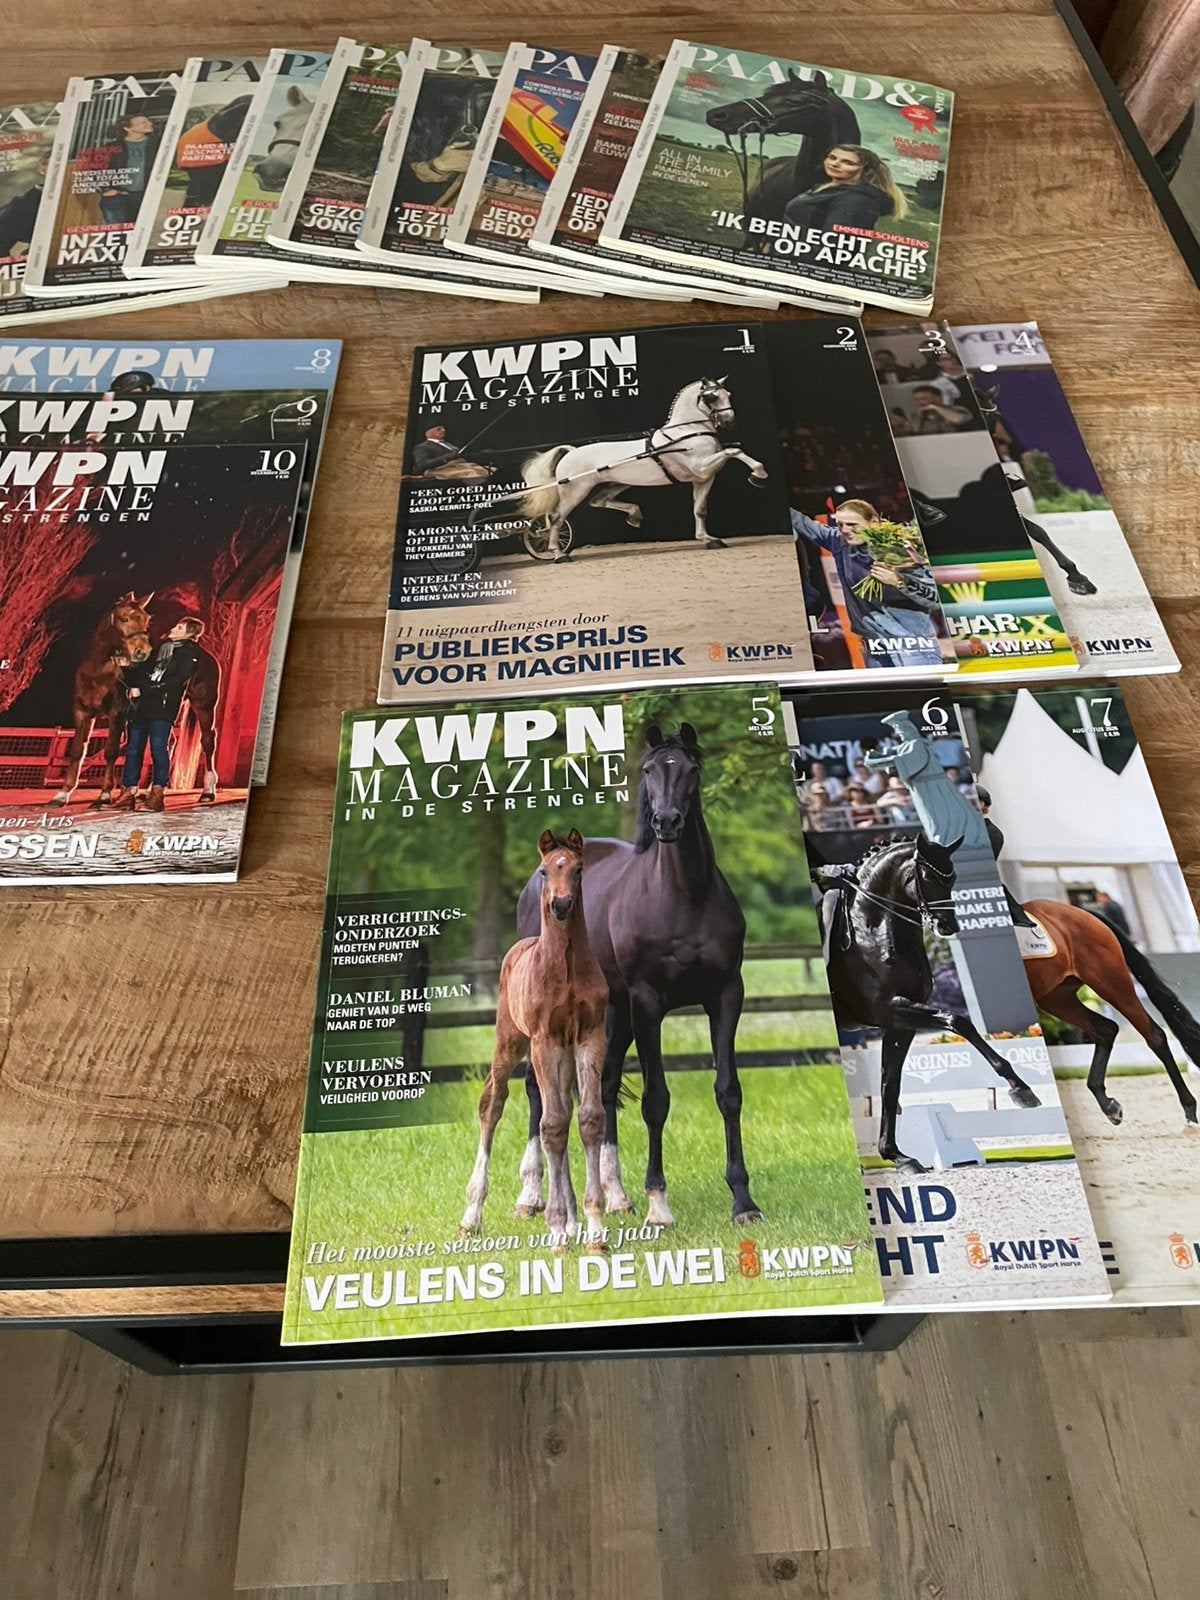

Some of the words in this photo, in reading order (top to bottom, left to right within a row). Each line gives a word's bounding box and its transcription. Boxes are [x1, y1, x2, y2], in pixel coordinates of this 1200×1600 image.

[658, 148, 684, 160] ALL
[687, 153, 702, 164] IN
[652, 170, 663, 178] IN
[664, 172, 677, 181] DE
[654, 164, 697, 179] PAARDEN
[658, 156, 683, 169] THE
[685, 163, 733, 179] FAMILY
[71, 181, 110, 189] ANDERS
[96, 173, 130, 182] TOTAAL
[309, 203, 365, 221] GEZO
[482, 206, 536, 227] JERO
[163, 215, 202, 232] OP
[397, 220, 436, 238] TOT
[568, 219, 598, 233] OP
[749, 216, 801, 241] BEN
[806, 228, 872, 254] ECHT
[876, 241, 929, 267] GEK
[832, 224, 876, 238] EMMELIE
[875, 231, 930, 249] SCHOLTENS
[57, 245, 127, 266] MAXI
[774, 238, 811, 257] OP
[836, 326, 858, 345] 2
[925, 330, 947, 349] 3
[1015, 331, 1033, 350] 4
[311, 348, 332, 369] 8
[421, 335, 638, 383] KWPN
[737, 329, 751, 347] 1
[419, 365, 639, 405] MAGAZINE
[296, 398, 318, 420] 9
[418, 405, 442, 415] IN
[462, 401, 488, 411] DE
[507, 387, 639, 407] STRENGEN
[259, 449, 297, 472] 10
[446, 485, 484, 495] GOED
[409, 505, 438, 514] SASKIA
[439, 501, 493, 512] GERRITS-POEL
[410, 496, 455, 507] LOOPT
[2, 512, 151, 524] STRENGEN
[407, 524, 481, 537] KARONIA.L
[484, 519, 533, 531] KROON
[405, 545, 417, 553] DE
[417, 543, 454, 552] FOKKERIJ
[456, 542, 473, 550] VAN
[406, 536, 426, 546] OP
[429, 534, 458, 545] HET
[461, 531, 501, 542] WERK
[405, 553, 425, 561] THEY
[426, 550, 466, 559] LEMMERS
[402, 573, 460, 585] INTEELT
[464, 572, 483, 581] EN
[402, 579, 512, 595] VERWANTSCHAP
[400, 595, 411, 603] DE
[412, 593, 441, 602] GRENS
[442, 592, 460, 600] VAN
[461, 590, 479, 598] VIJF
[480, 587, 518, 597] PROCENT
[418, 614, 568, 639] tuigpaardhengsten
[572, 611, 610, 626] door
[394, 624, 648, 662] PUBLIEKSPRIJS
[727, 643, 793, 659] KWPN
[868, 636, 934, 651] KWPN
[986, 638, 1052, 654] KWPN
[1086, 637, 1152, 653] KWPN
[391, 662, 487, 687] VOOR
[497, 646, 686, 681] MAGNIFIEK
[921, 696, 949, 726] 6
[1091, 697, 1113, 727] 7
[350, 704, 626, 769] KWPN
[752, 696, 776, 726] 5
[346, 753, 629, 805] MAGAZINE
[345, 807, 376, 821] IN
[402, 803, 436, 818] DE
[462, 790, 630, 813] STRENGEN
[145, 835, 219, 851] KWPN
[336, 907, 467, 927] VERRICHTINGS-
[955, 902, 994, 916] MAKE
[997, 900, 1010, 912] IT
[958, 915, 1015, 931] HAPPEN
[335, 924, 441, 942] ONDERZOEK
[333, 942, 376, 954] MOETEN
[378, 940, 420, 951] PUNTEN
[333, 952, 403, 966] TERUGKEREN?
[329, 990, 395, 1006] DANIEL
[400, 983, 472, 1002] BLUMAN
[328, 1007, 365, 1018] GENIET
[367, 1005, 390, 1016] VAN
[391, 1004, 406, 1014] DE
[407, 1002, 432, 1013] WEG
[327, 1019, 357, 1031] NAAR
[359, 1018, 373, 1030] DE
[375, 1017, 396, 1028] TOP
[323, 1056, 405, 1074] VEULENS
[321, 1070, 433, 1091] VERVOEREN
[320, 1091, 379, 1105] VEILIGHEID
[381, 1087, 426, 1101] VOOROP
[306, 1241, 346, 1265] Het
[353, 1237, 436, 1261] mooiste
[442, 1231, 520, 1256] seizoen
[528, 1232, 569, 1249] van
[575, 1221, 610, 1245] het
[613, 1220, 665, 1249] jaar
[989, 1238, 1079, 1264] KWPN
[763, 1245, 853, 1271] KWPN
[875, 1234, 945, 1277] HT
[764, 1271, 785, 1281] Royal
[786, 1269, 809, 1278] Dutch
[810, 1268, 831, 1279] Sport
[832, 1266, 854, 1275] Horse
[994, 1263, 1015, 1272] Royal
[1016, 1261, 1038, 1270] Dutch
[1039, 1261, 1059, 1271] Sport
[1060, 1259, 1082, 1268] Horse
[303, 1262, 506, 1312] VEULENS
[519, 1257, 564, 1296] IN
[578, 1252, 637, 1292] DE
[644, 1247, 726, 1287] WEI
